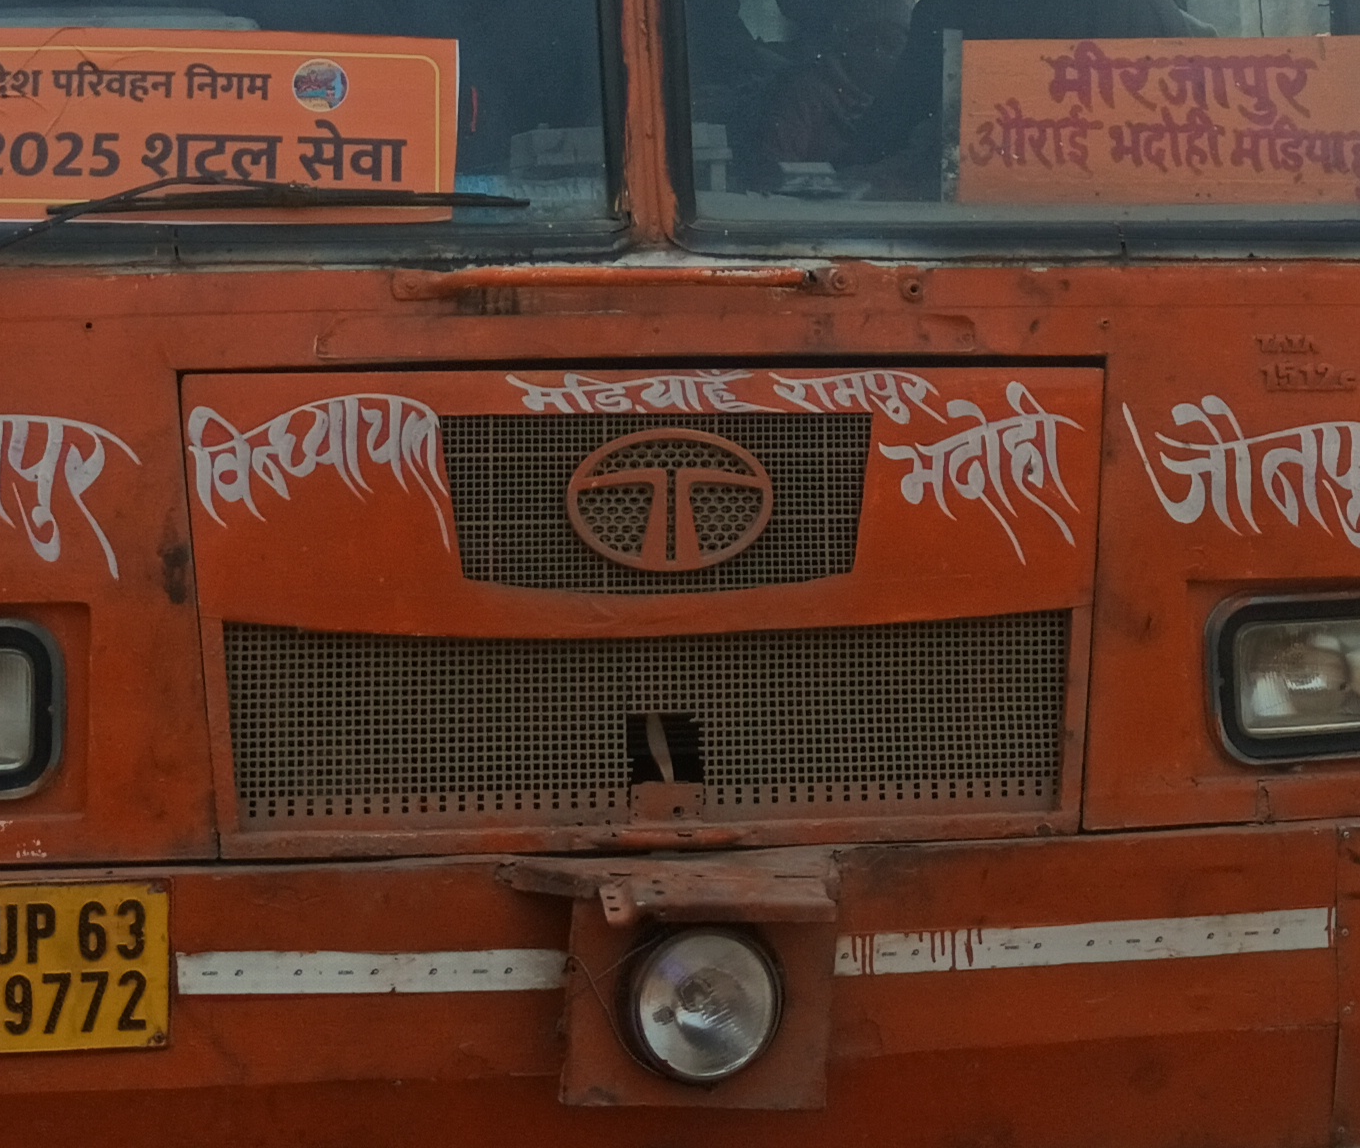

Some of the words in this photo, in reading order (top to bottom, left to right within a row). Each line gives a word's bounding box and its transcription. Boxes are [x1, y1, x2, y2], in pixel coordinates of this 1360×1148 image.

[53, 64, 175, 102] परिवहन
[185, 63, 270, 101] निगम
[1042, 40, 1318, 127] मीरजापुर
[298, 119, 408, 183] सेवा
[770, 370, 948, 425] रामपुर
[879, 382, 1086, 566] भदोही
[78, 899, 146, 960] 63
